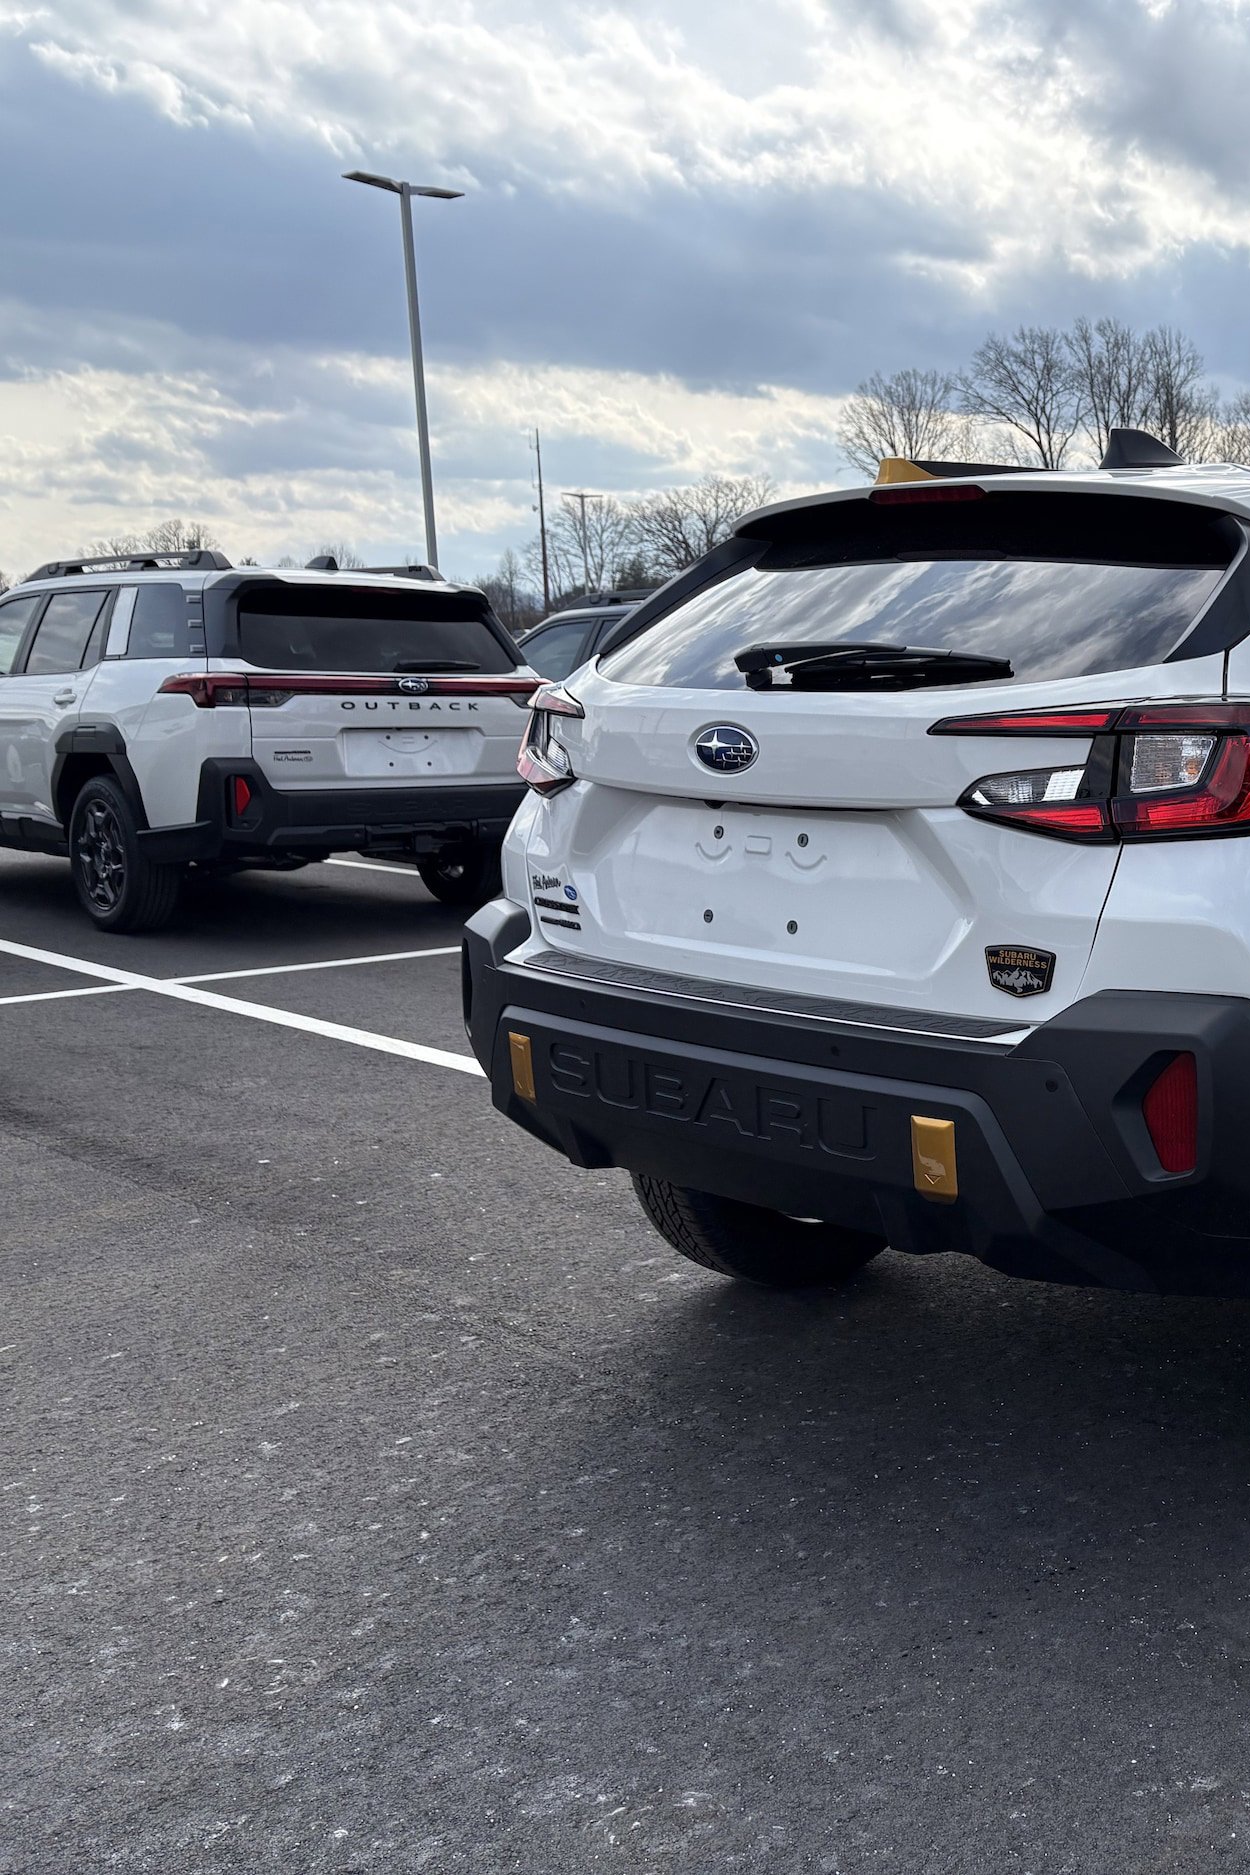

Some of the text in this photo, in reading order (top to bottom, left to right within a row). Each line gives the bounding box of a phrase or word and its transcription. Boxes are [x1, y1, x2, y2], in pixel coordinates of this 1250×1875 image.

[341, 701, 479, 711] OUTBACK
[999, 950, 1036, 960] SUBARU
[989, 956, 1047, 969] WILDERNESS
[550, 1042, 877, 1161] SUBARU
